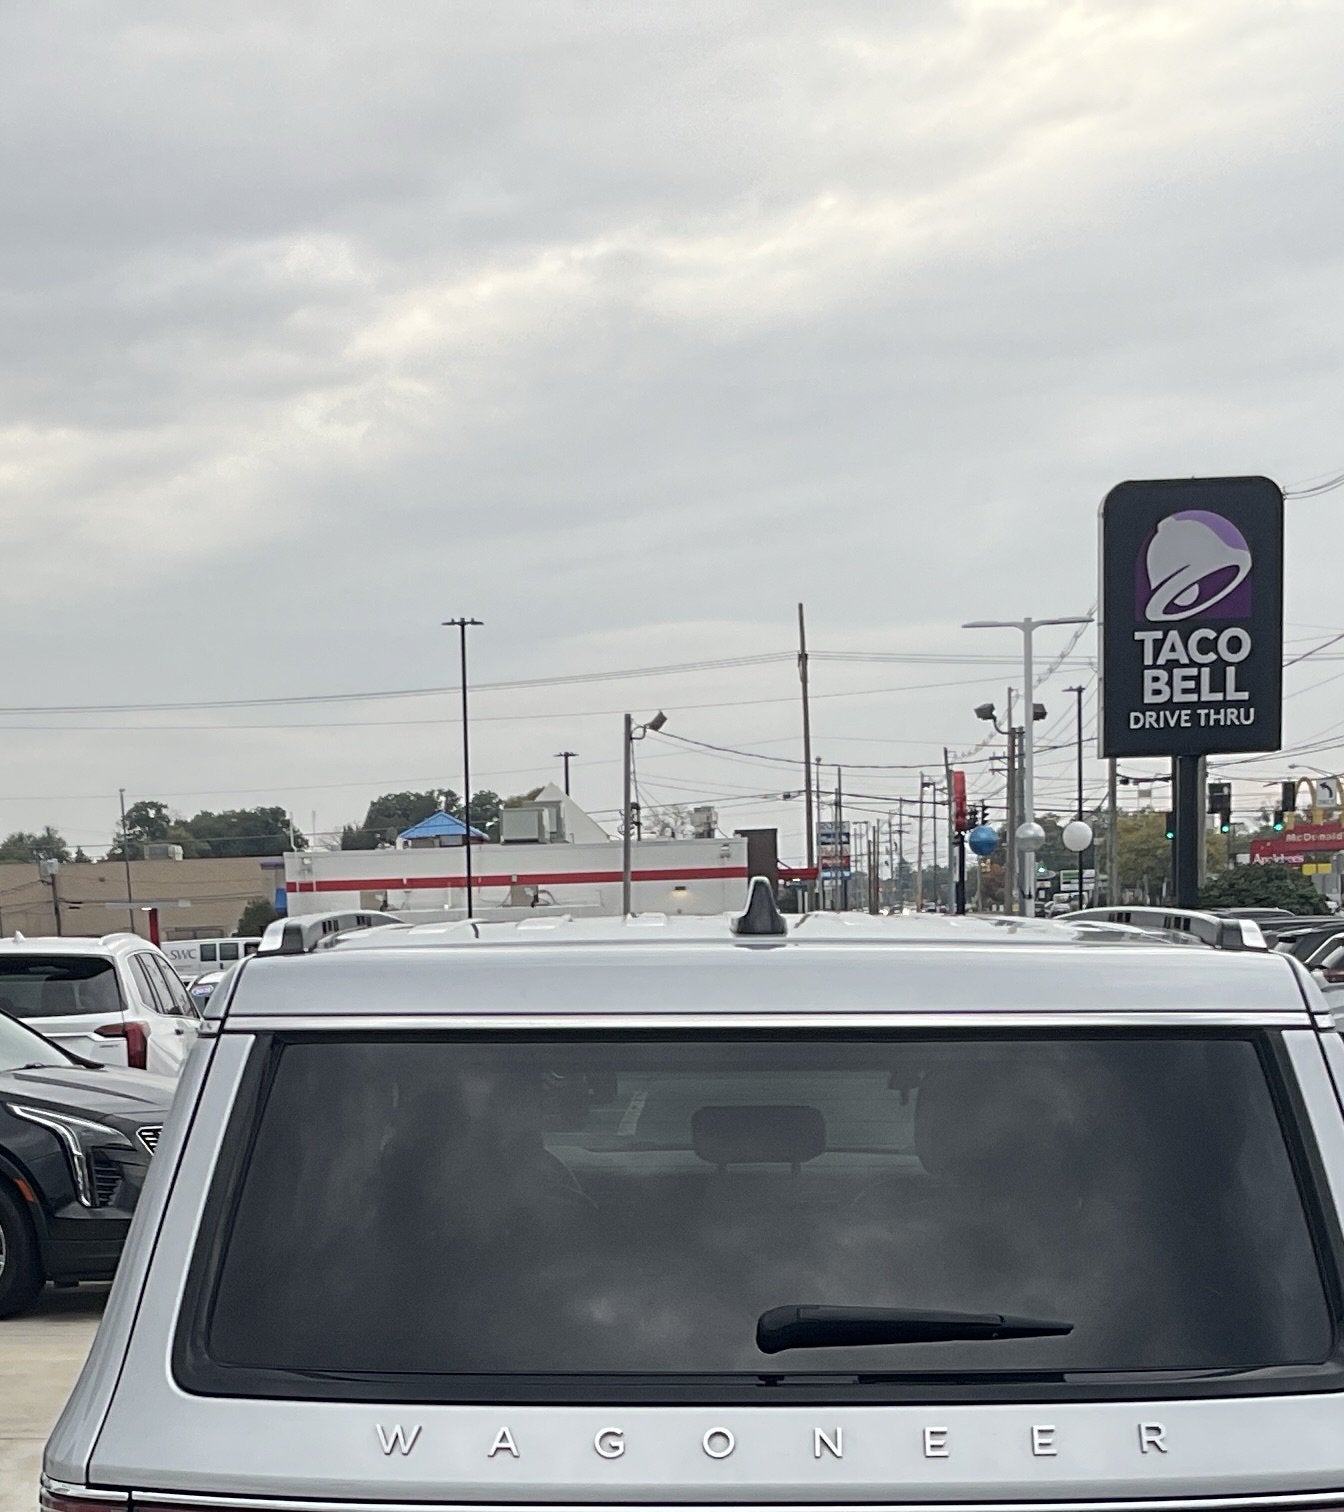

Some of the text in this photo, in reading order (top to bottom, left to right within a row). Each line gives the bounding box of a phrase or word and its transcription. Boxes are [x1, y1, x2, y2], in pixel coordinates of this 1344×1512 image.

[1134, 627, 1252, 666] TACO
[1143, 666, 1250, 704] BELL
[1129, 707, 1255, 730] DRIVE THRU
[375, 1420, 1168, 1459] WAGONEER
